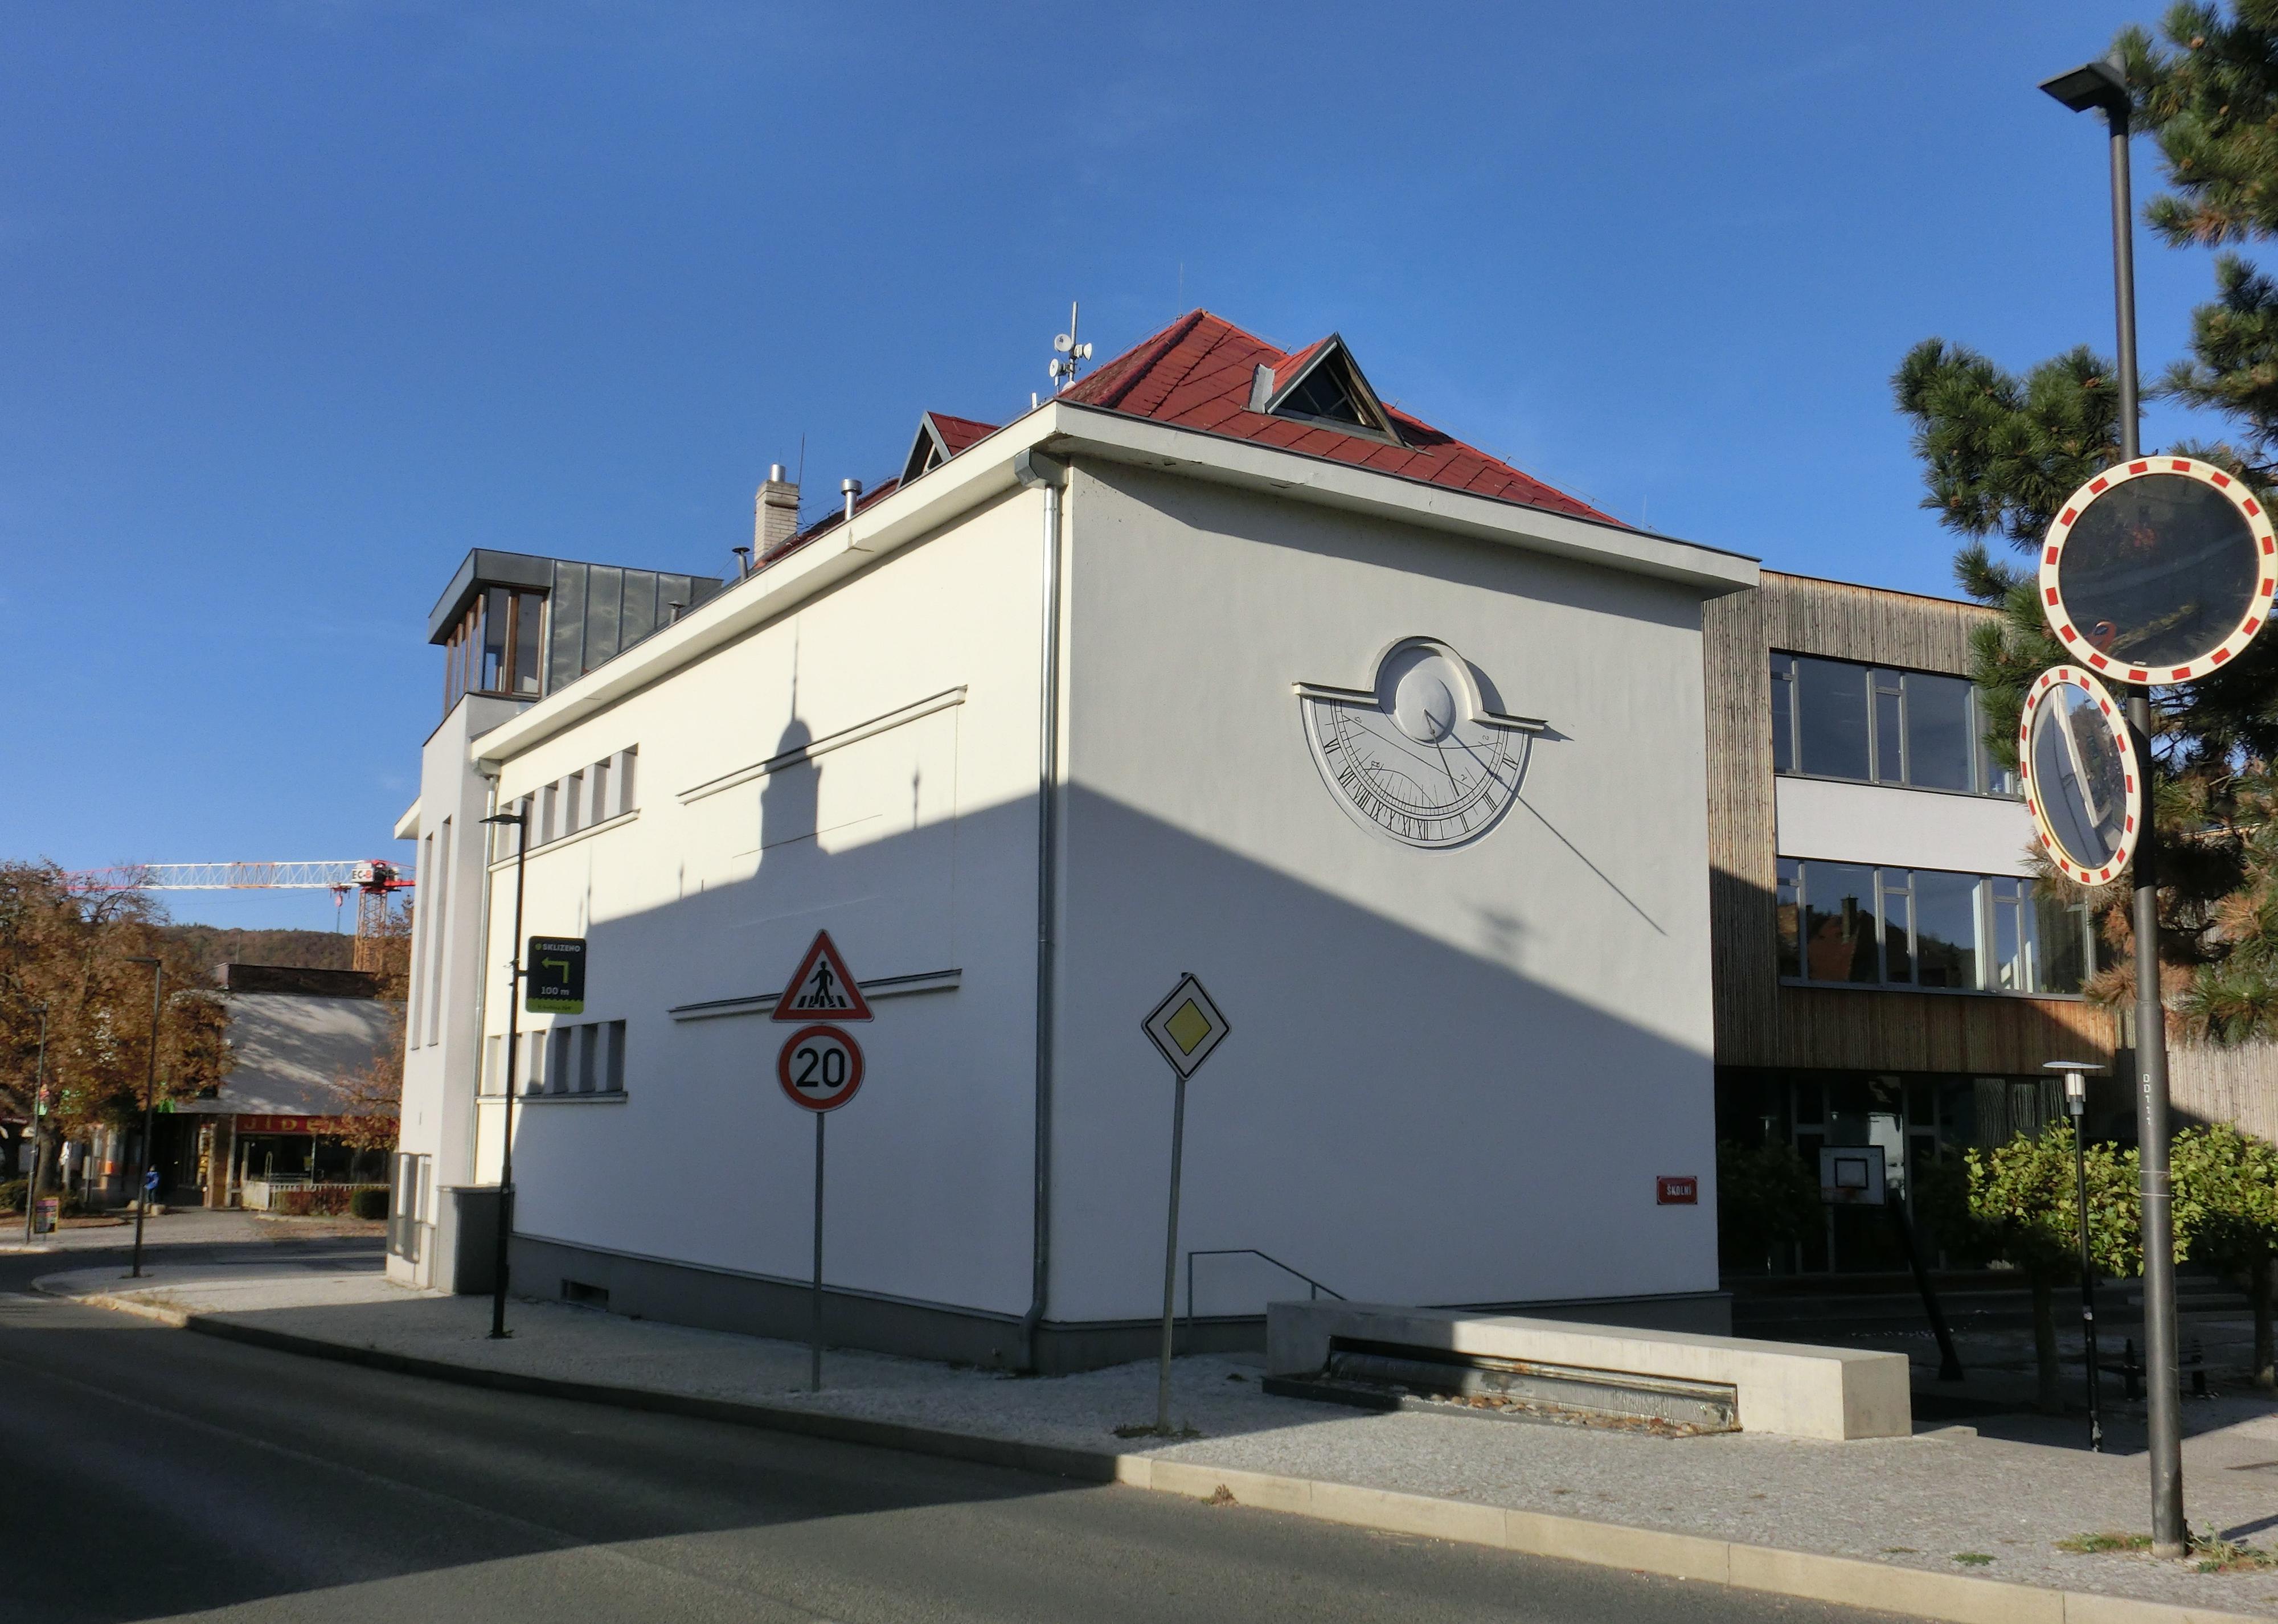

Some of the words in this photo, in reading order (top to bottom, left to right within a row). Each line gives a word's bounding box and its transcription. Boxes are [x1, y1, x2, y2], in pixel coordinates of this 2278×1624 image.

[542, 943, 580, 952] SKLIZENO
[796, 1047, 845, 1088] 20
[1667, 1184, 1691, 1196] ŠKOLNÍ
